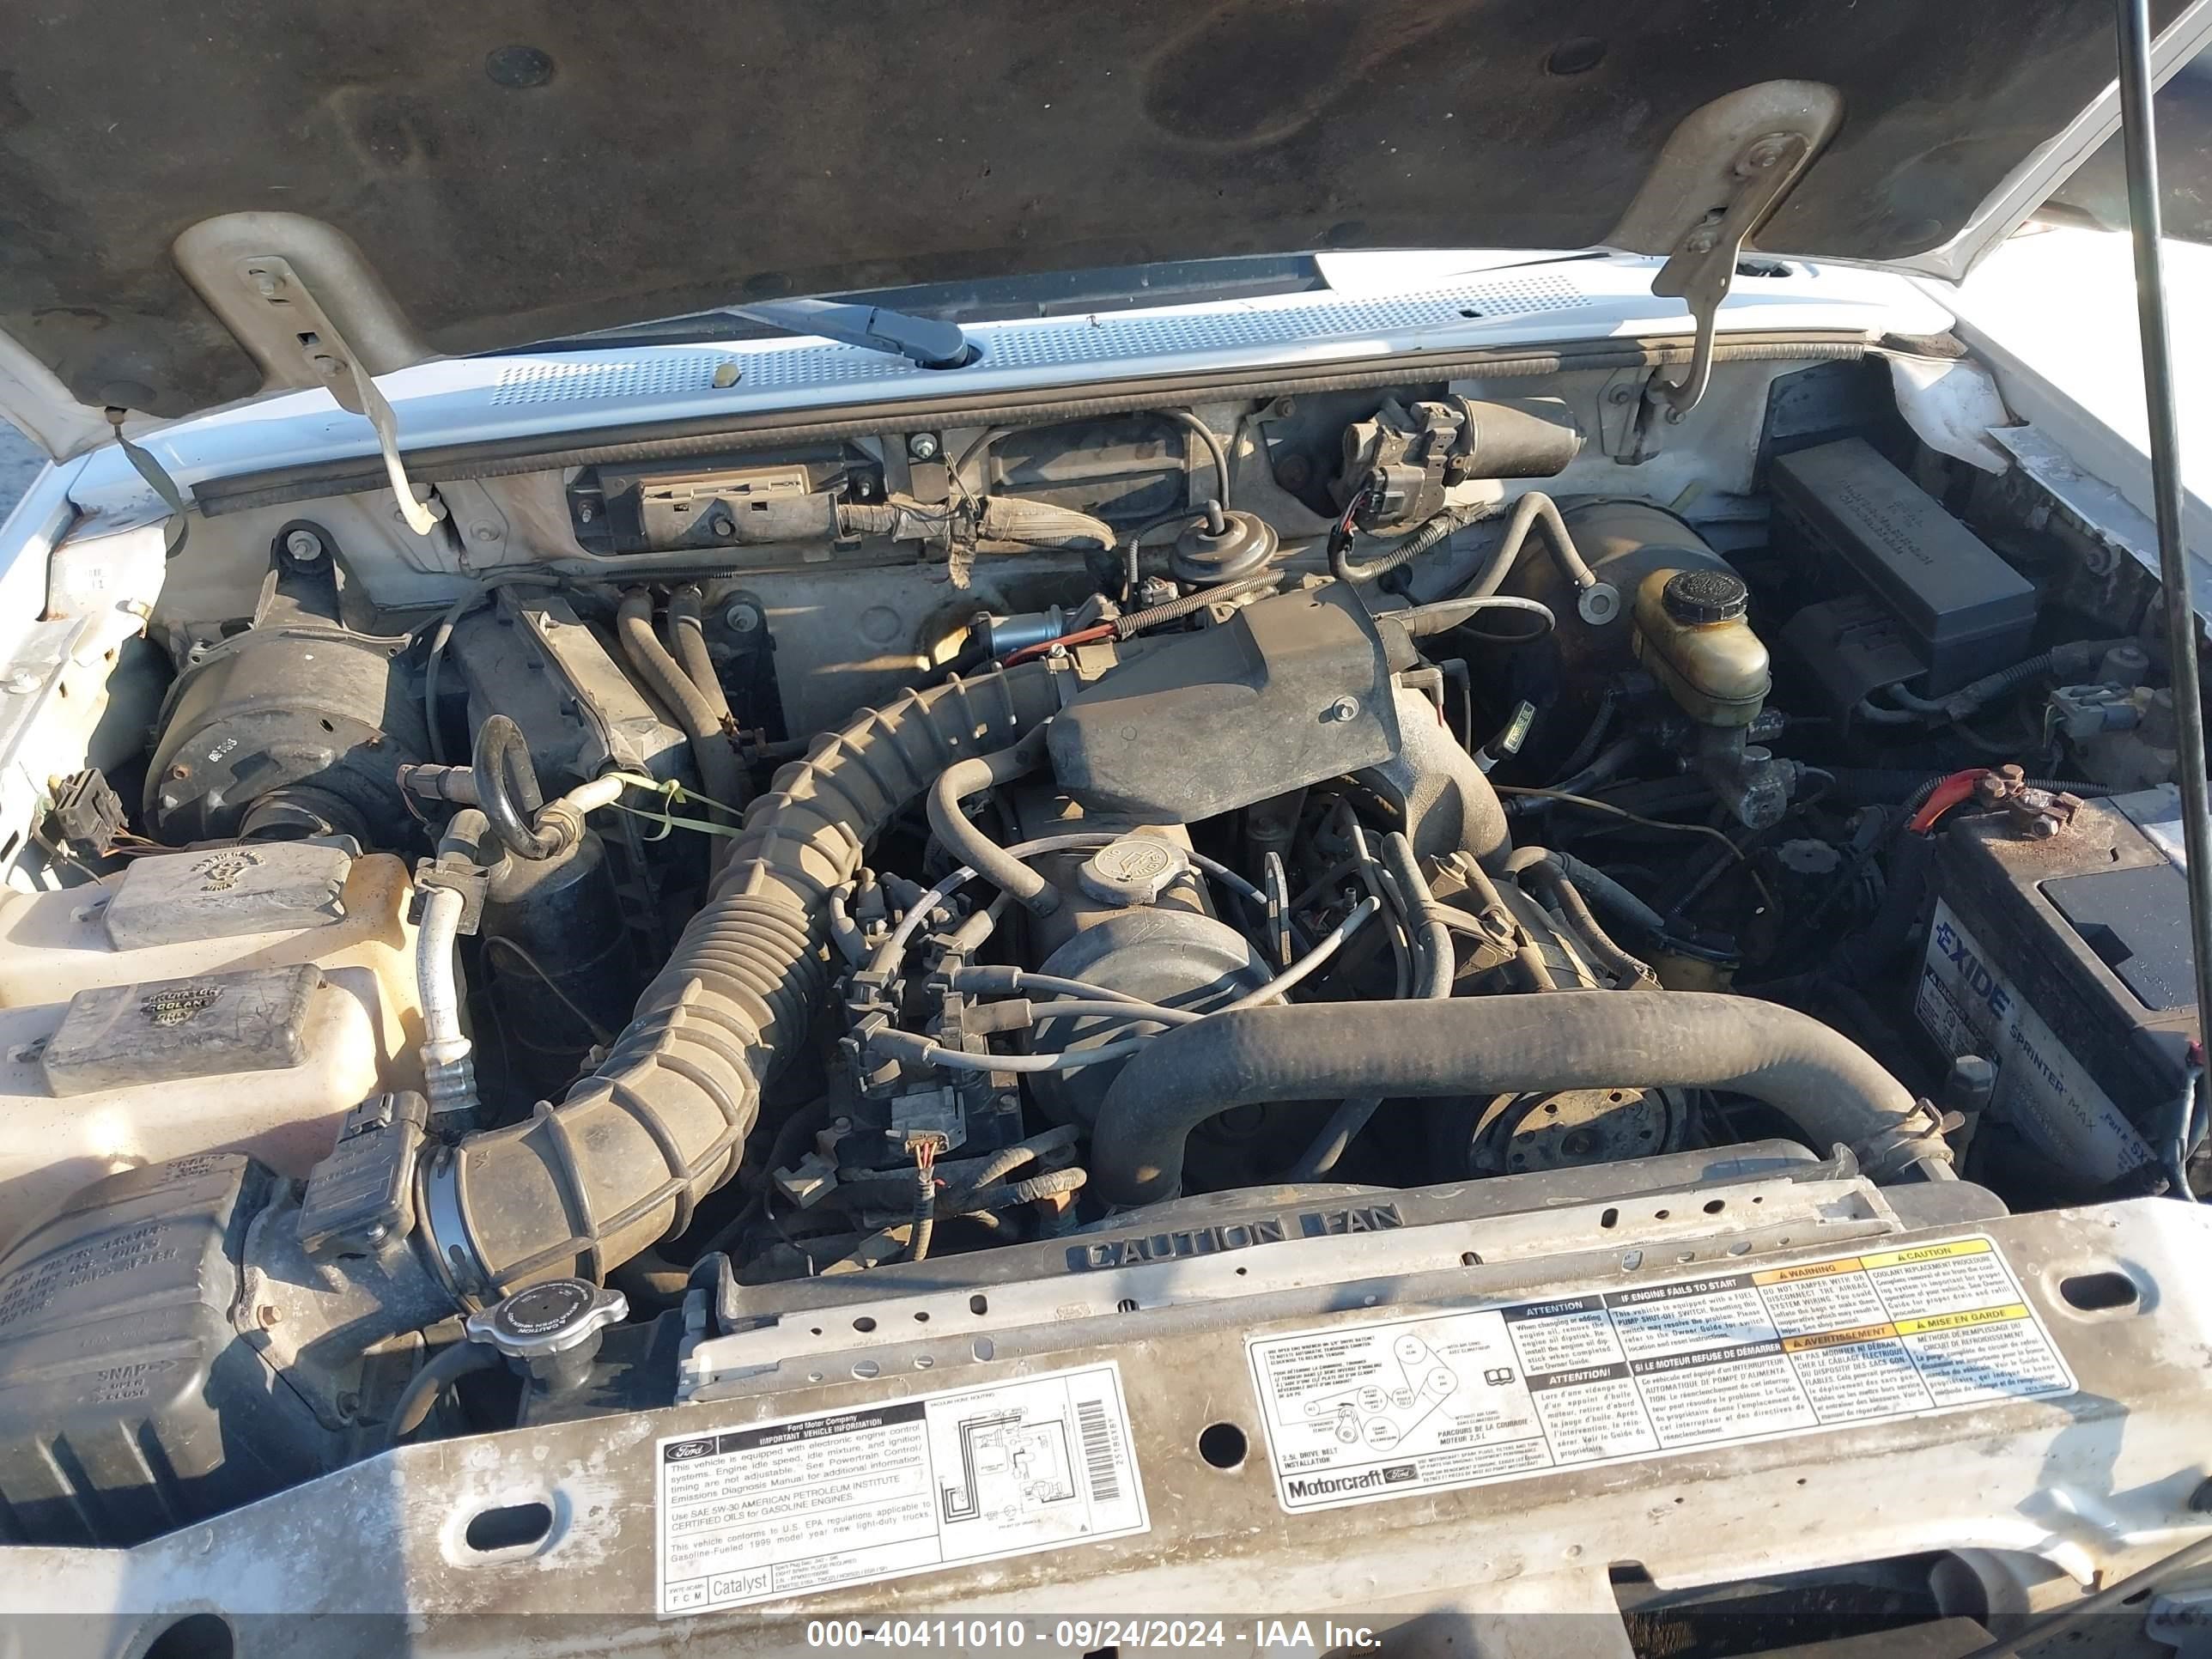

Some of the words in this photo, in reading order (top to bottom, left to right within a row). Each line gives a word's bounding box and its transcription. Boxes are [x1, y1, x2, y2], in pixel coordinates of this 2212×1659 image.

[1936, 921, 2012, 1021] EXIDE
[2068, 1096, 2096, 1133] MAX
[1086, 1217, 1287, 1268] CAUTION
[1322, 1202, 1405, 1234] FAN
[1905, 1247, 1953, 1259] CAUTION
[1787, 1264, 1838, 1277] WARNING
[1630, 1289, 1667, 1301] ENGINE
[1665, 1285, 1693, 1296] FAILS
[1692, 1283, 1708, 1291] TO
[1707, 1279, 1738, 1290] START
[1525, 1301, 1583, 1316] ATTENTION
[1925, 1317, 1954, 1327] MISE
[1969, 1310, 2008, 1321] GARDE
[517, 1323, 560, 1334] CAUTION
[1516, 1322, 1536, 1331] When
[1536, 1318, 1570, 1329] changing
[1577, 1313, 1601, 1323] adding
[1518, 1331, 1545, 1340] engine
[1802, 1327, 1887, 1346] AVERTISSEMENT
[1571, 1346, 1614, 1357] completed.
[1643, 1361, 1656, 1370] LE
[1654, 1356, 1692, 1369] MOTEUR
[1690, 1352, 1723, 1363] REFUSE
[1722, 1349, 1737, 1358] DE
[1735, 1342, 1781, 1356] DÉMARRER
[97, 1364, 149, 1382] SNAP
[1544, 1360, 1568, 1369] Owner
[1568, 1357, 1592, 1365] Guide.
[1547, 1368, 1612, 1384] ATTENTION!
[760, 1431, 799, 1444] IMPORTANT
[803, 1426, 832, 1437] VEHICLE
[834, 1418, 882, 1432] INFORMATION
[787, 1423, 803, 1431] Ford
[805, 1419, 823, 1429] Motor
[825, 1413, 858, 1426] Company
[1437, 1427, 1473, 1437] PARCOURS
[1495, 1419, 1529, 1428] COURROIE
[671, 1463, 690, 1472] This
[694, 1457, 725, 1468] vehicle
[740, 1448, 782, 1462] equipped
[808, 1436, 851, 1449] electronic
[855, 1431, 886, 1442] engine
[888, 1424, 919, 1435] control
[1439, 1436, 1468, 1444] MOTEUR
[715, 1463, 749, 1476] Engine
[751, 1460, 768, 1468] idle
[772, 1455, 802, 1466] speed,
[828, 1445, 863, 1455] mixture,
[889, 1434, 921, 1446] ignition
[1284, 1456, 1330, 1468] INSTALLATION
[671, 1482, 698, 1494] timing
[744, 1466, 795, 1480] adjustable.
[805, 1461, 824, 1469] See
[830, 1451, 878, 1465] Powertrain
[671, 1489, 717, 1504] Emissions
[722, 1480, 766, 1496] Diagnosis
[770, 1474, 803, 1486] Manual
[823, 1464, 866, 1477] additional
[870, 1454, 922, 1468] information.
[1286, 1468, 1384, 1498] Motorcraft
[672, 1512, 689, 1521] Use
[690, 1508, 710, 1517] SAE
[711, 1503, 739, 1514] 5W-30
[741, 1494, 790, 1509] AMERICAN
[793, 1483, 850, 1499] PETROLEUM
[853, 1474, 900, 1489] INSTITUTE
[672, 1516, 720, 1530] CERTIFIED
[723, 1511, 744, 1522] OILS
[761, 1500, 810, 1515] GASOLINE
[671, 1542, 689, 1552] This
[693, 1536, 722, 1548] vehicle
[726, 1529, 765, 1541] conforms
[804, 1518, 823, 1528] EPA
[827, 1511, 872, 1526] regulations
[875, 1503, 918, 1516] applicable
[671, 1543, 743, 1562] Gasoline-Fueled
[750, 1538, 770, 1547] 1999
[775, 1533, 803, 1543] model
[809, 1529, 827, 1539] year
[856, 1516, 896, 1530] light-duty
[902, 1510, 931, 1521] trucks.
[714, 1572, 767, 1598] Catalyst
